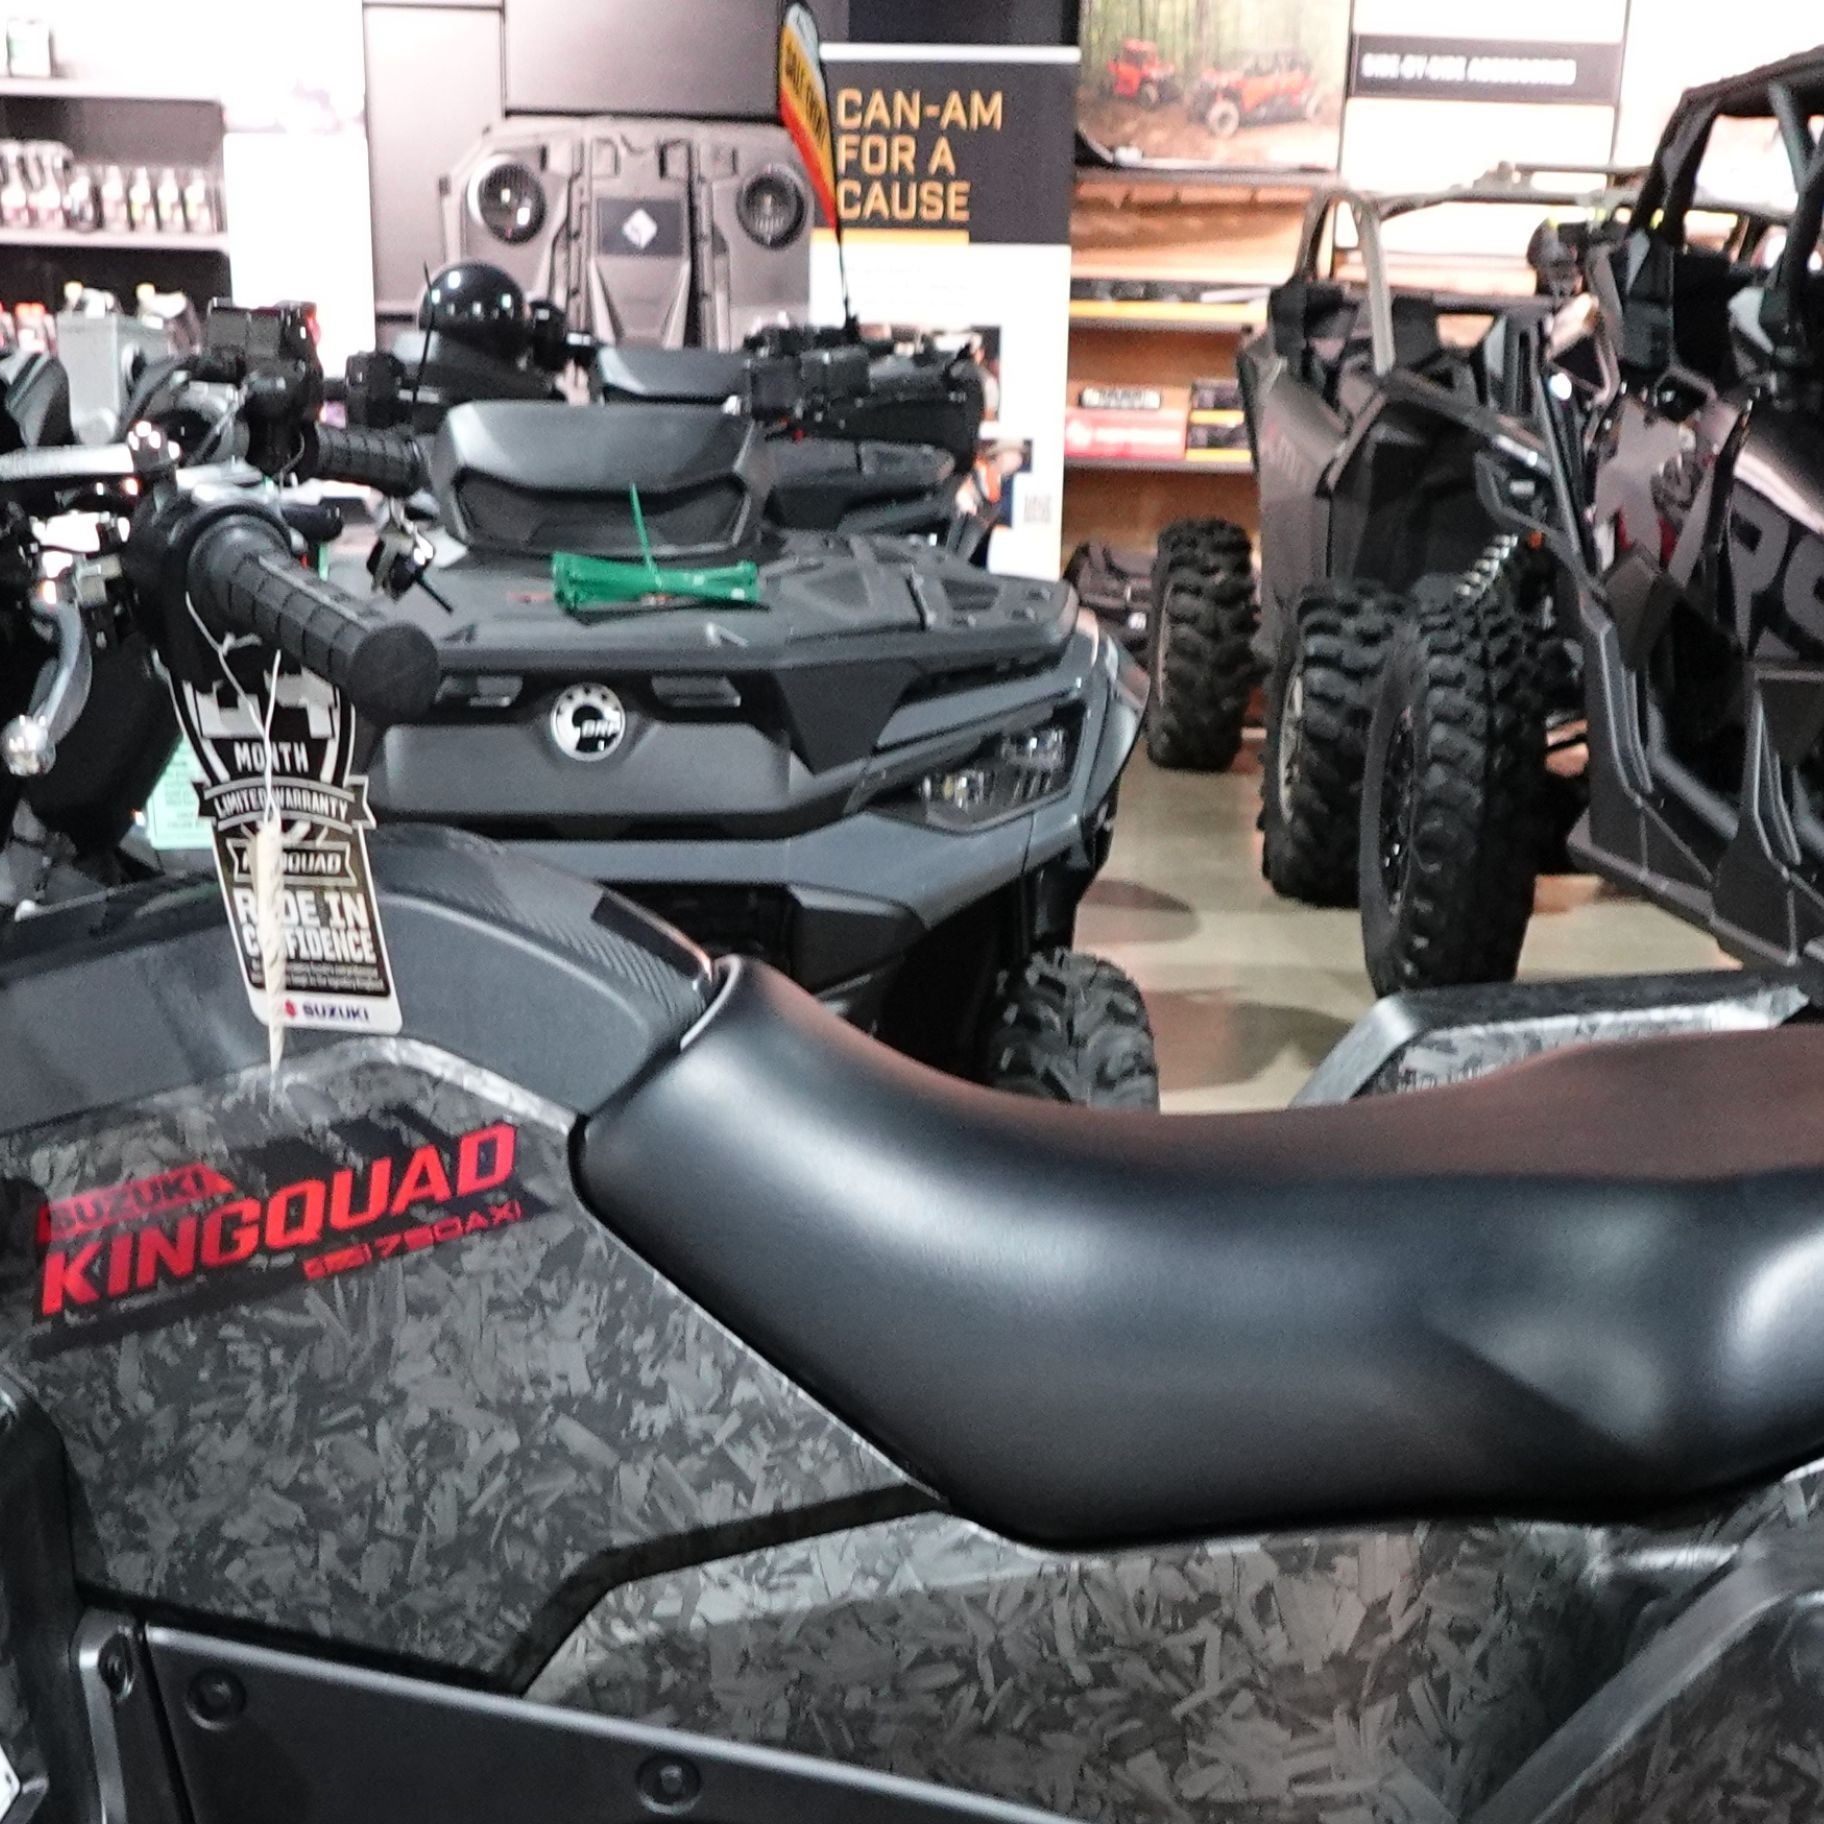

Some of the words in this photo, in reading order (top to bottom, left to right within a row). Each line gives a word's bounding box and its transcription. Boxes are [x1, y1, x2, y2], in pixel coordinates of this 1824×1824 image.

[836, 88, 1003, 131] CAN-AM
[836, 133, 916, 176] FOR
[928, 135, 956, 176] A
[836, 179, 971, 222] CAUSE
[234, 741, 310, 774] MONTH
[214, 787, 268, 820] LIMITED
[234, 888, 320, 928] RDE
[325, 891, 370, 930] IN
[242, 923, 376, 963] CFIDENCE
[302, 1004, 369, 1021] SUZUKI
[41, 1121, 517, 1317] KINGQUAD
